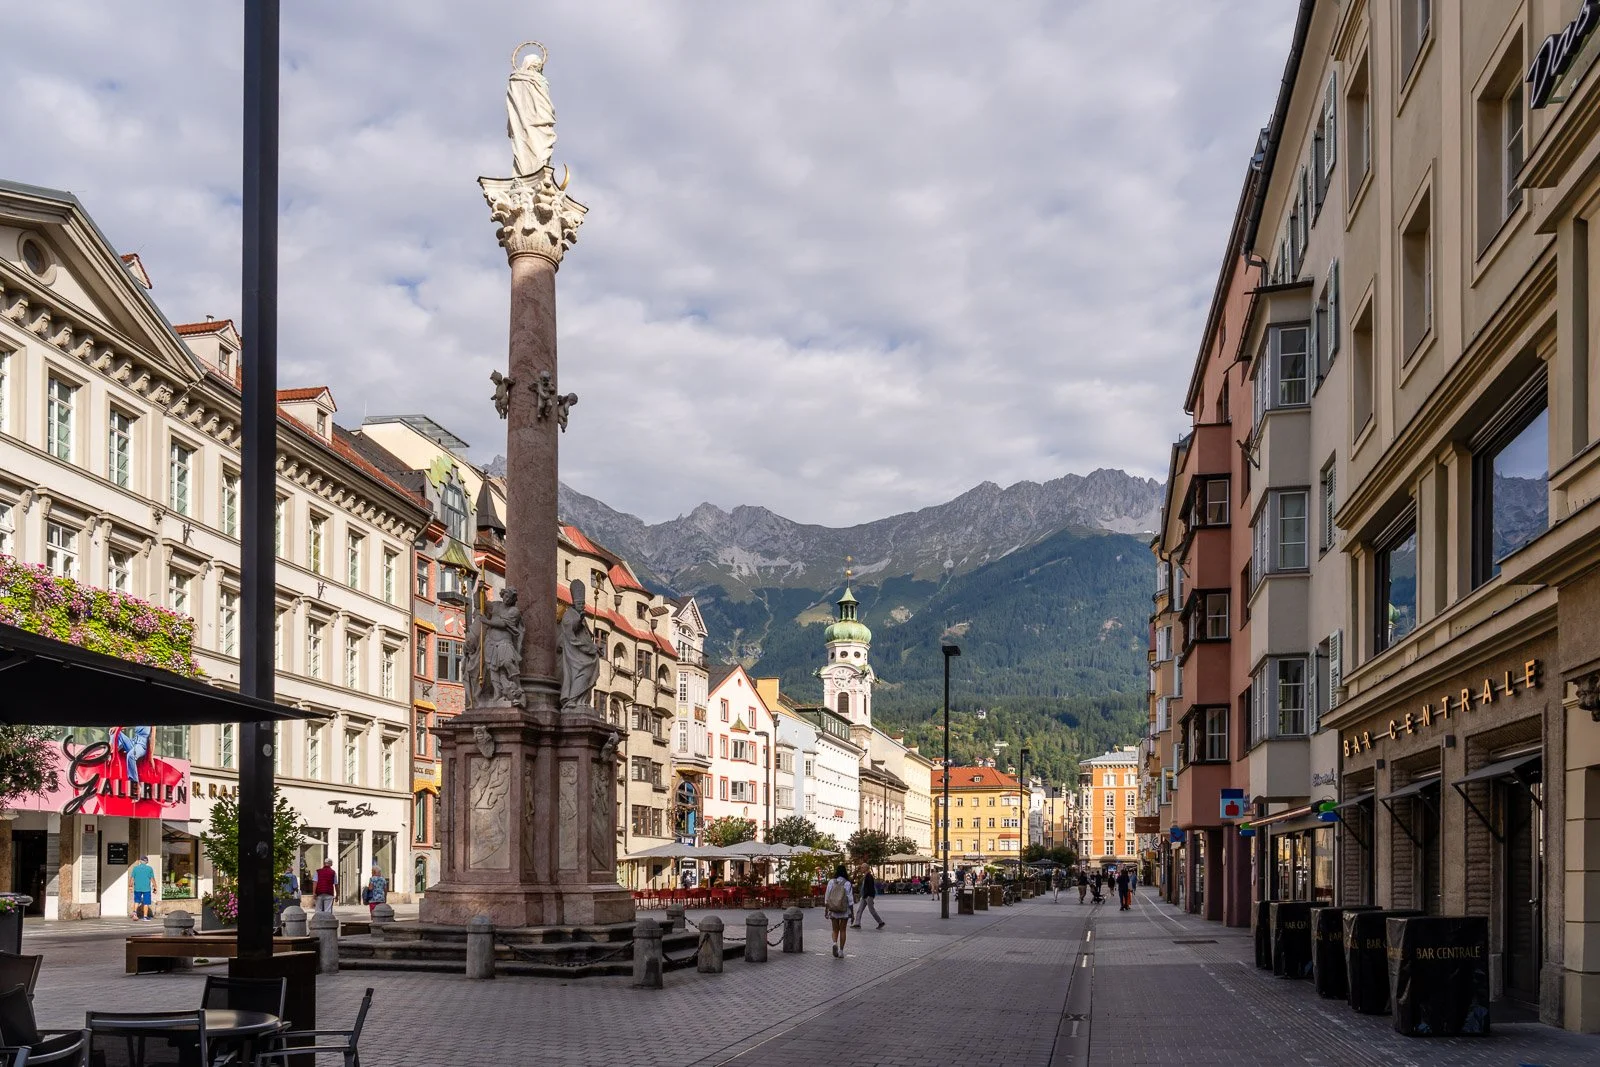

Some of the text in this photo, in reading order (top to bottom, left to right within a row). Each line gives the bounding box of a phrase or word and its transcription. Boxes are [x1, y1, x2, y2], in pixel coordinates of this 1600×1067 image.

[1343, 659, 1538, 758] BAR CENTRALE
[1366, 938, 1381, 949] BAR
[1416, 947, 1434, 960] BAR
[1436, 945, 1481, 959] CENTRALE
